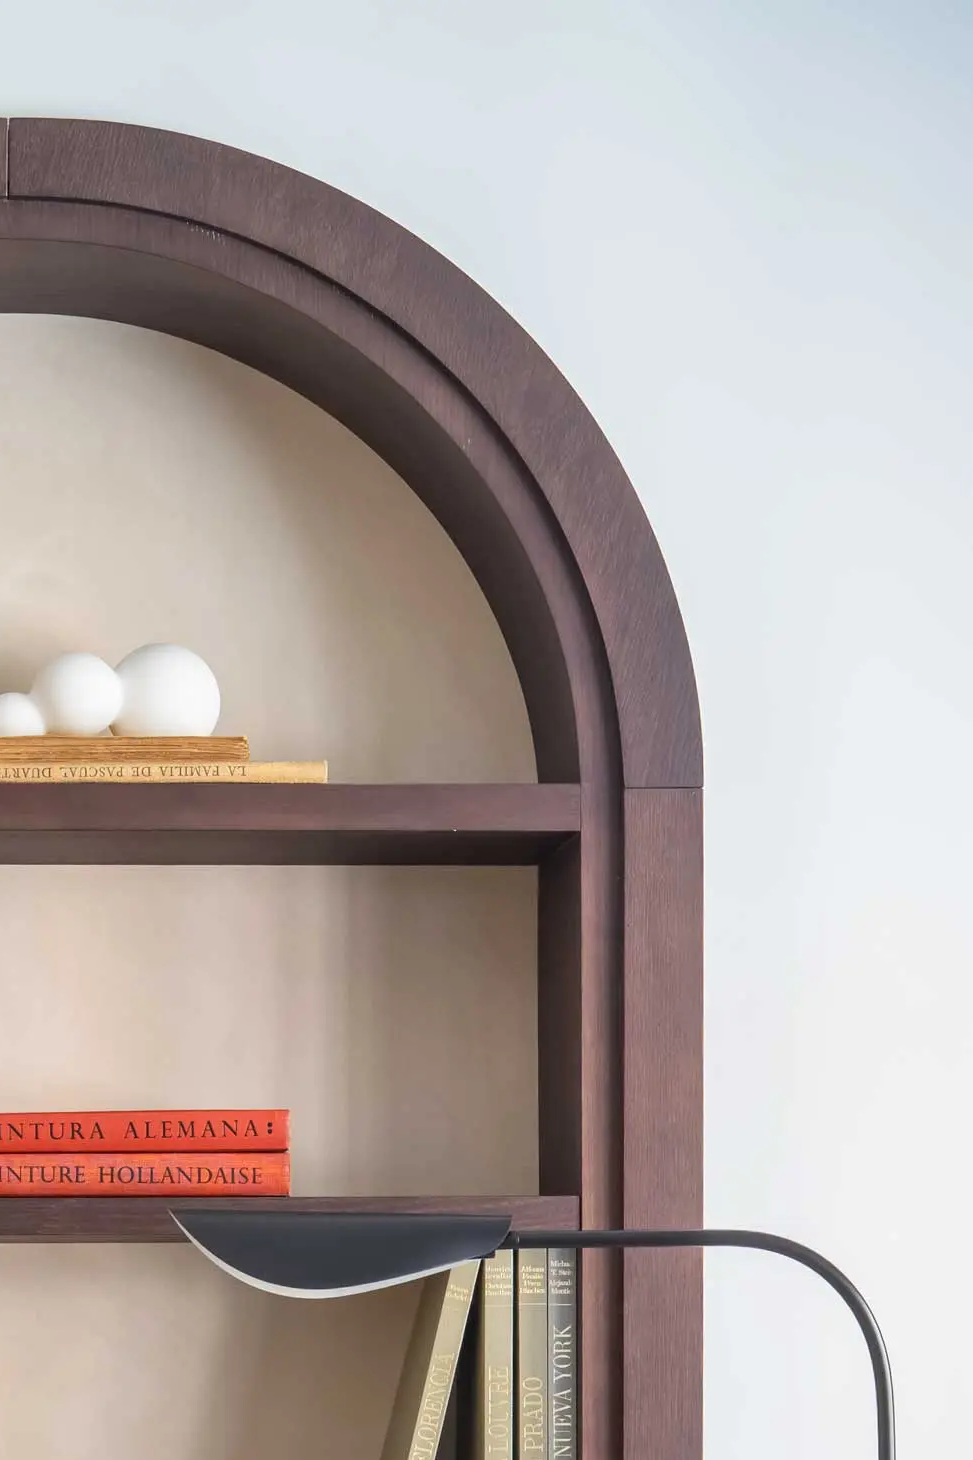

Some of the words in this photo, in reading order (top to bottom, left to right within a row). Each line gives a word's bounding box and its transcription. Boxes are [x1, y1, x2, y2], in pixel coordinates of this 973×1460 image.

[59, 766, 124, 778] PASCUAL
[132, 766, 152, 777] DE
[159, 765, 220, 777] FAMILIA
[226, 765, 247, 777] LA
[123, 1119, 260, 1140] ALEMANA
[98, 1166, 263, 1184] HOLLANDAISE
[553, 1324, 572, 1383] YORK
[487, 1366, 510, 1453] LOUVRE
[523, 1376, 544, 1451] PRADO
[553, 1387, 572, 1460] NUEVA
